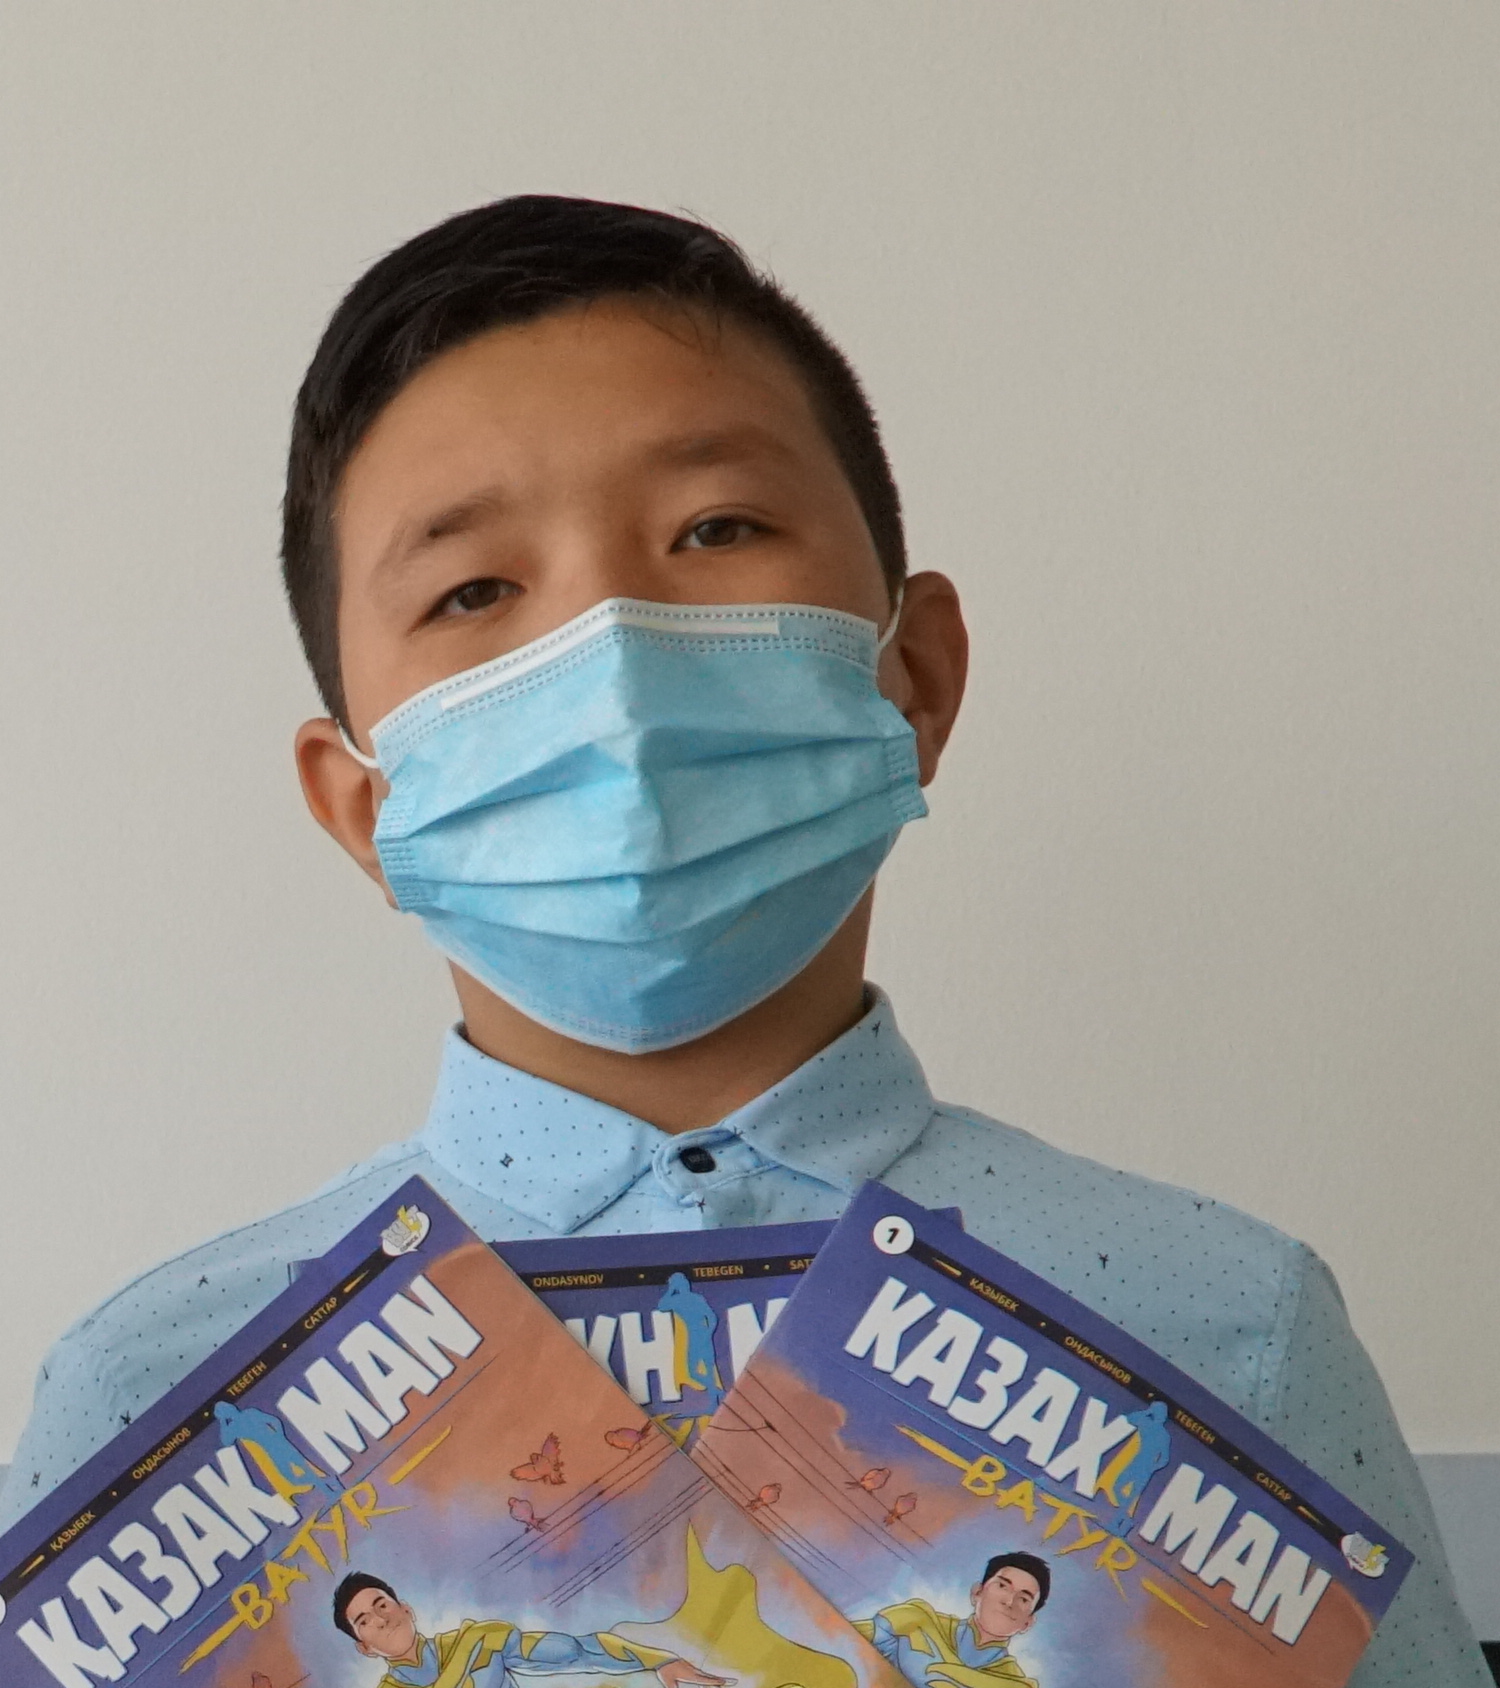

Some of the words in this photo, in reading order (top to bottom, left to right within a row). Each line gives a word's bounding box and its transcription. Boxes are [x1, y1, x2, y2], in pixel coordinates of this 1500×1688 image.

[533, 1274, 604, 1288] ONDASYNOV
[693, 1265, 744, 1277] TEBEGEN
[886, 1227, 900, 1244] 1
[227, 1361, 267, 1396] ТЕБЕГЕН
[304, 1297, 337, 1329] САТТАР
[277, 1274, 484, 1474] MAN
[969, 1278, 1019, 1312] КАЗЫБЕК
[1174, 1410, 1216, 1444] ТЕБЕГЕН
[1256, 1472, 1292, 1501] САТТАР
[844, 1277, 1135, 1499] КАЗАХ
[1139, 1463, 1332, 1647] MAN
[960, 1452, 1139, 1599] BATYR
[230, 1482, 411, 1631] BATYR
